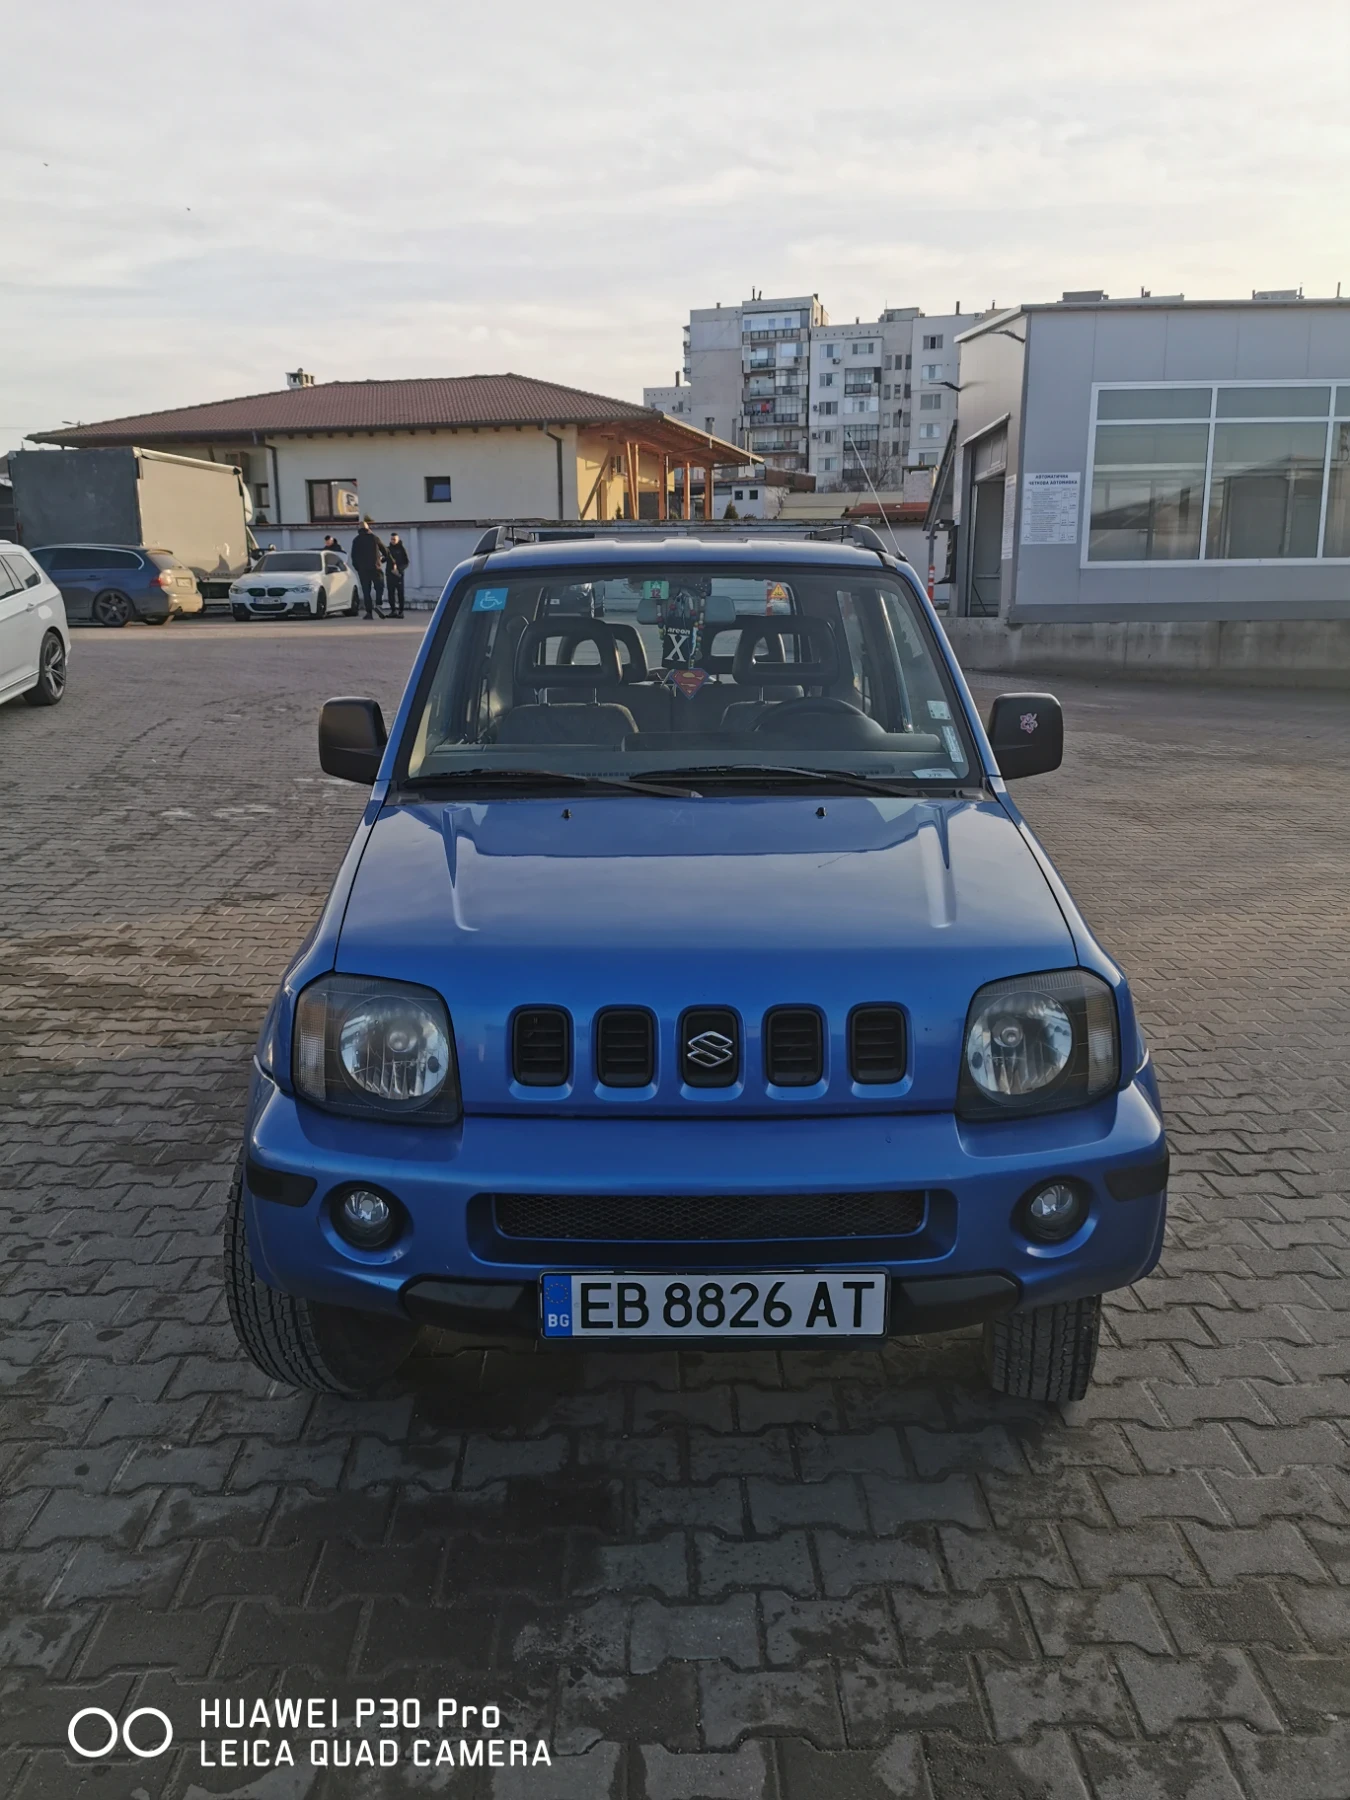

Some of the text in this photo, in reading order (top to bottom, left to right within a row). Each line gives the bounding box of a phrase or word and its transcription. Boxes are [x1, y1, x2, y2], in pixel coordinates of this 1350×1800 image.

[667, 627, 691, 635] areon
[664, 633, 690, 662] X
[580, 1281, 875, 1329] EB 8826 AT
[547, 1314, 570, 1328] BG
